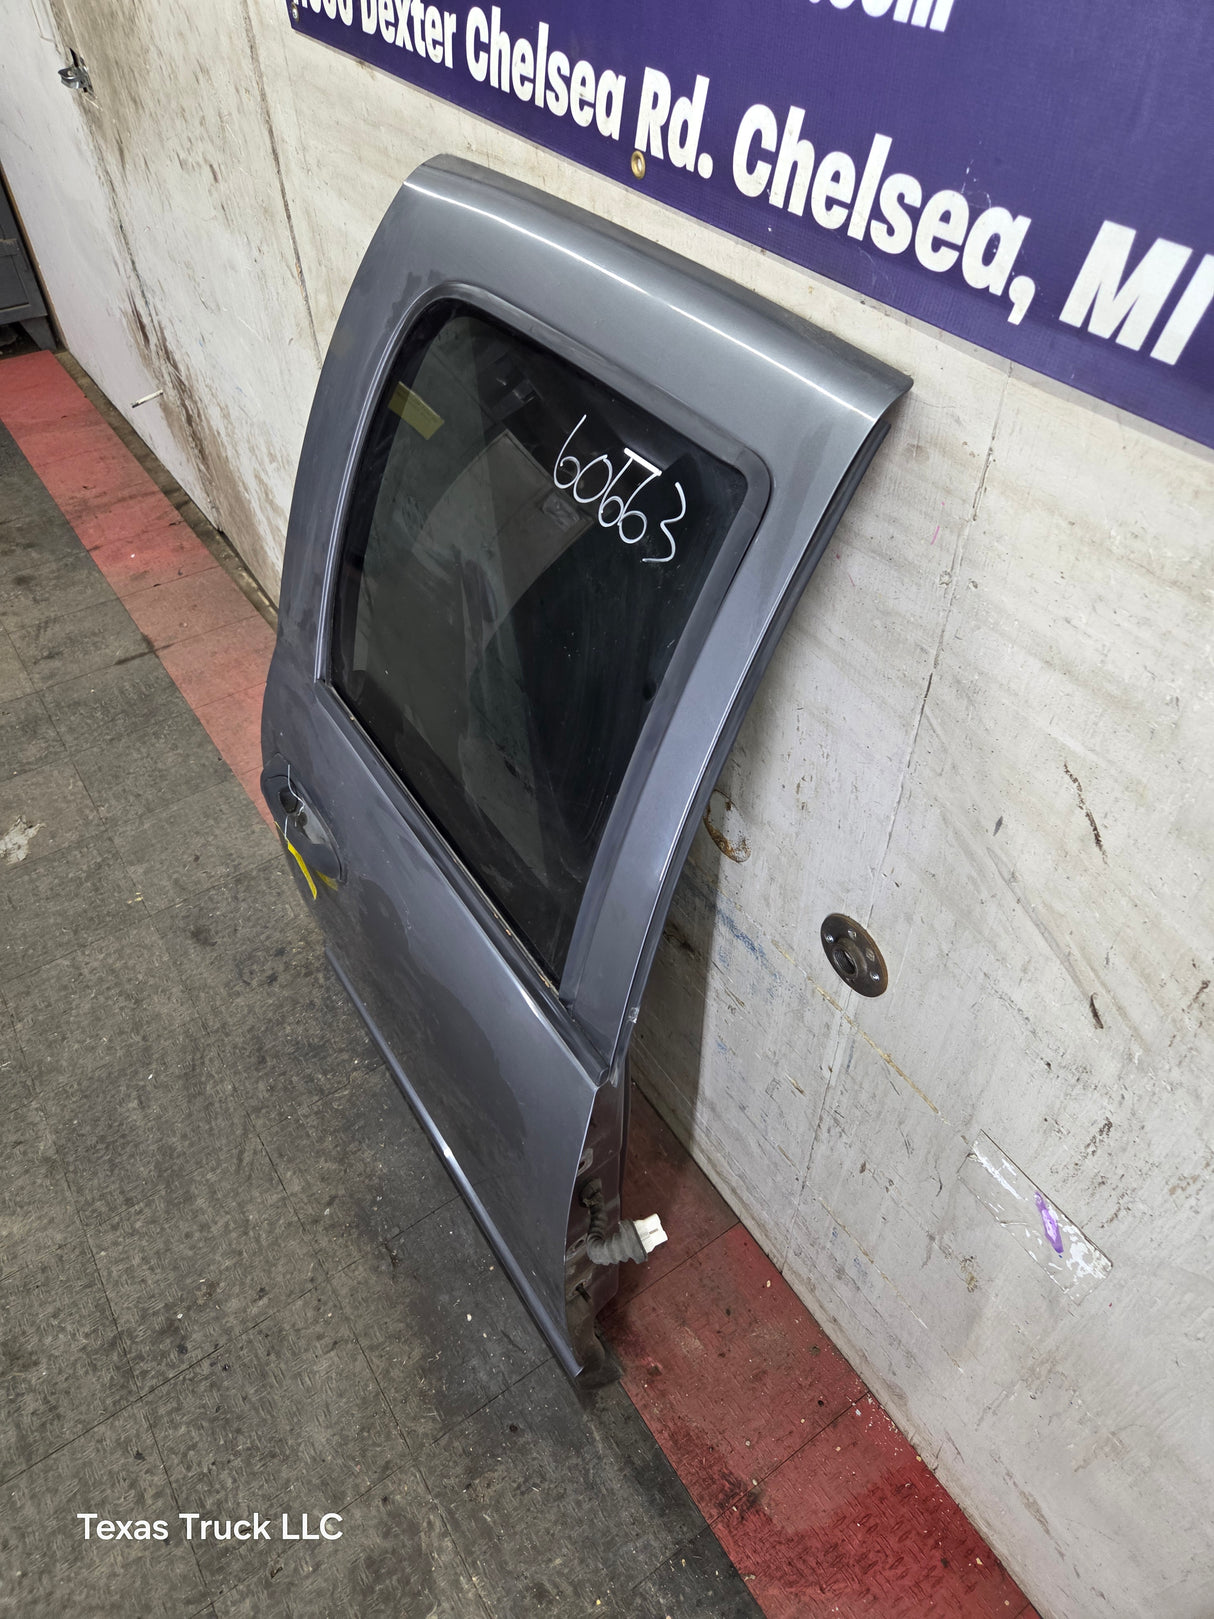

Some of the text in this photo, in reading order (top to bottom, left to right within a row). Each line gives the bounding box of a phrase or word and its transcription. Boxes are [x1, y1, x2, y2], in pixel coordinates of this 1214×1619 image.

[361, 0, 1214, 366] Dexter Chelsea Rd. Chelsea, MI
[553, 413, 687, 562] 60663
